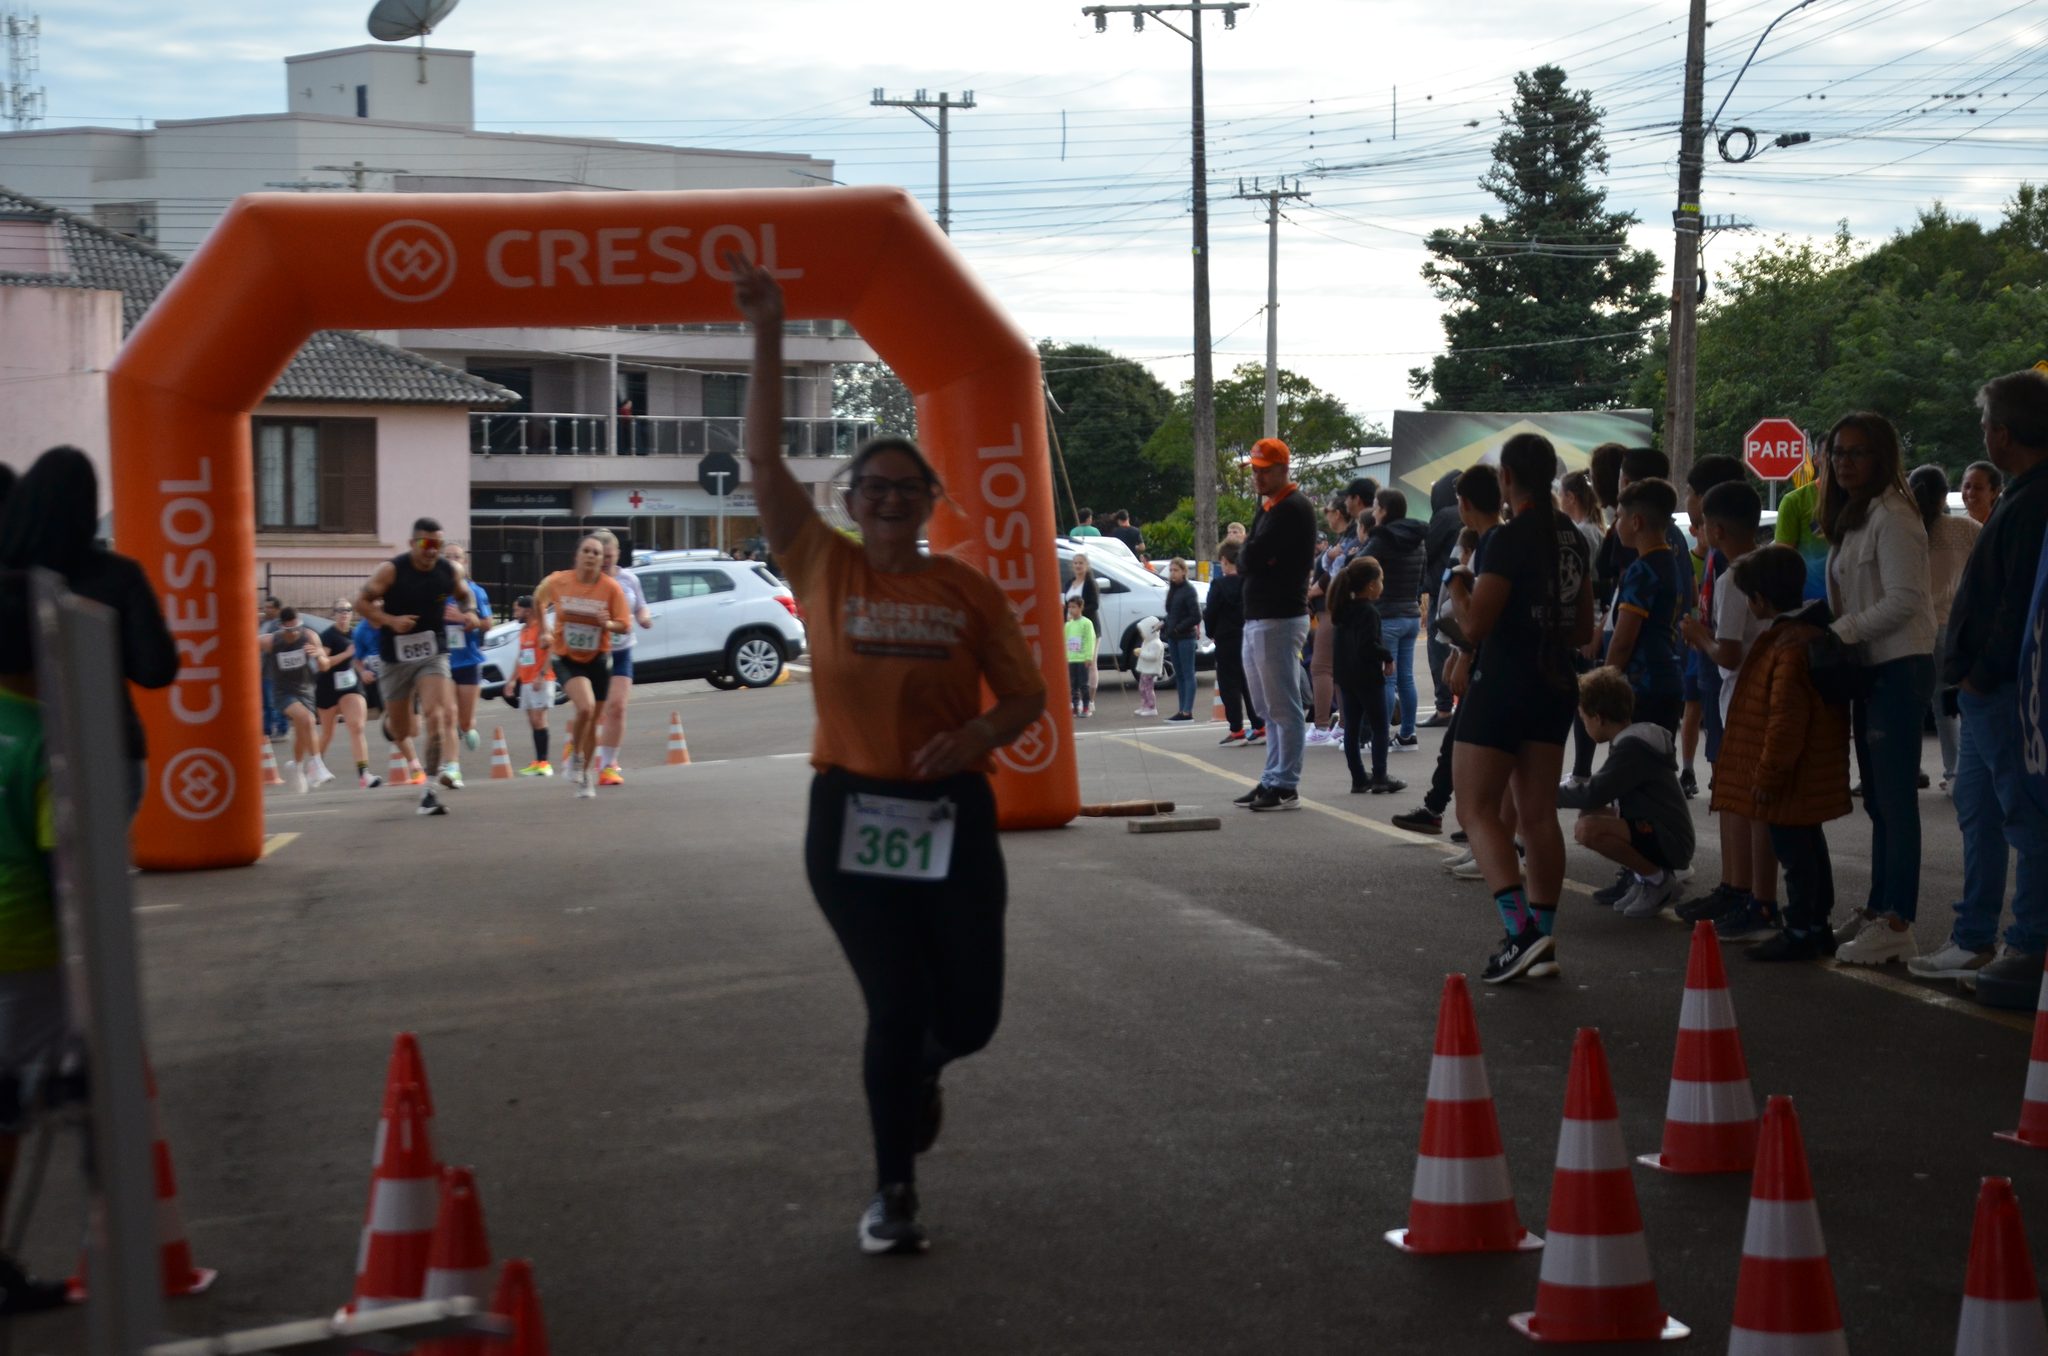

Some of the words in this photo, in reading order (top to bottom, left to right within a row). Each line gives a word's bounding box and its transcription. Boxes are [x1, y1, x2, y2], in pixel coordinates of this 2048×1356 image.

[486, 223, 804, 288] CRESOL
[1749, 441, 1802, 458] PARE
[978, 422, 1042, 669] RESOL
[158, 456, 222, 724] CRESOL
[403, 641, 432, 659] 689
[568, 631, 595, 648] 281
[857, 823, 933, 871] 361
[1499, 944, 1520, 967] FILA
